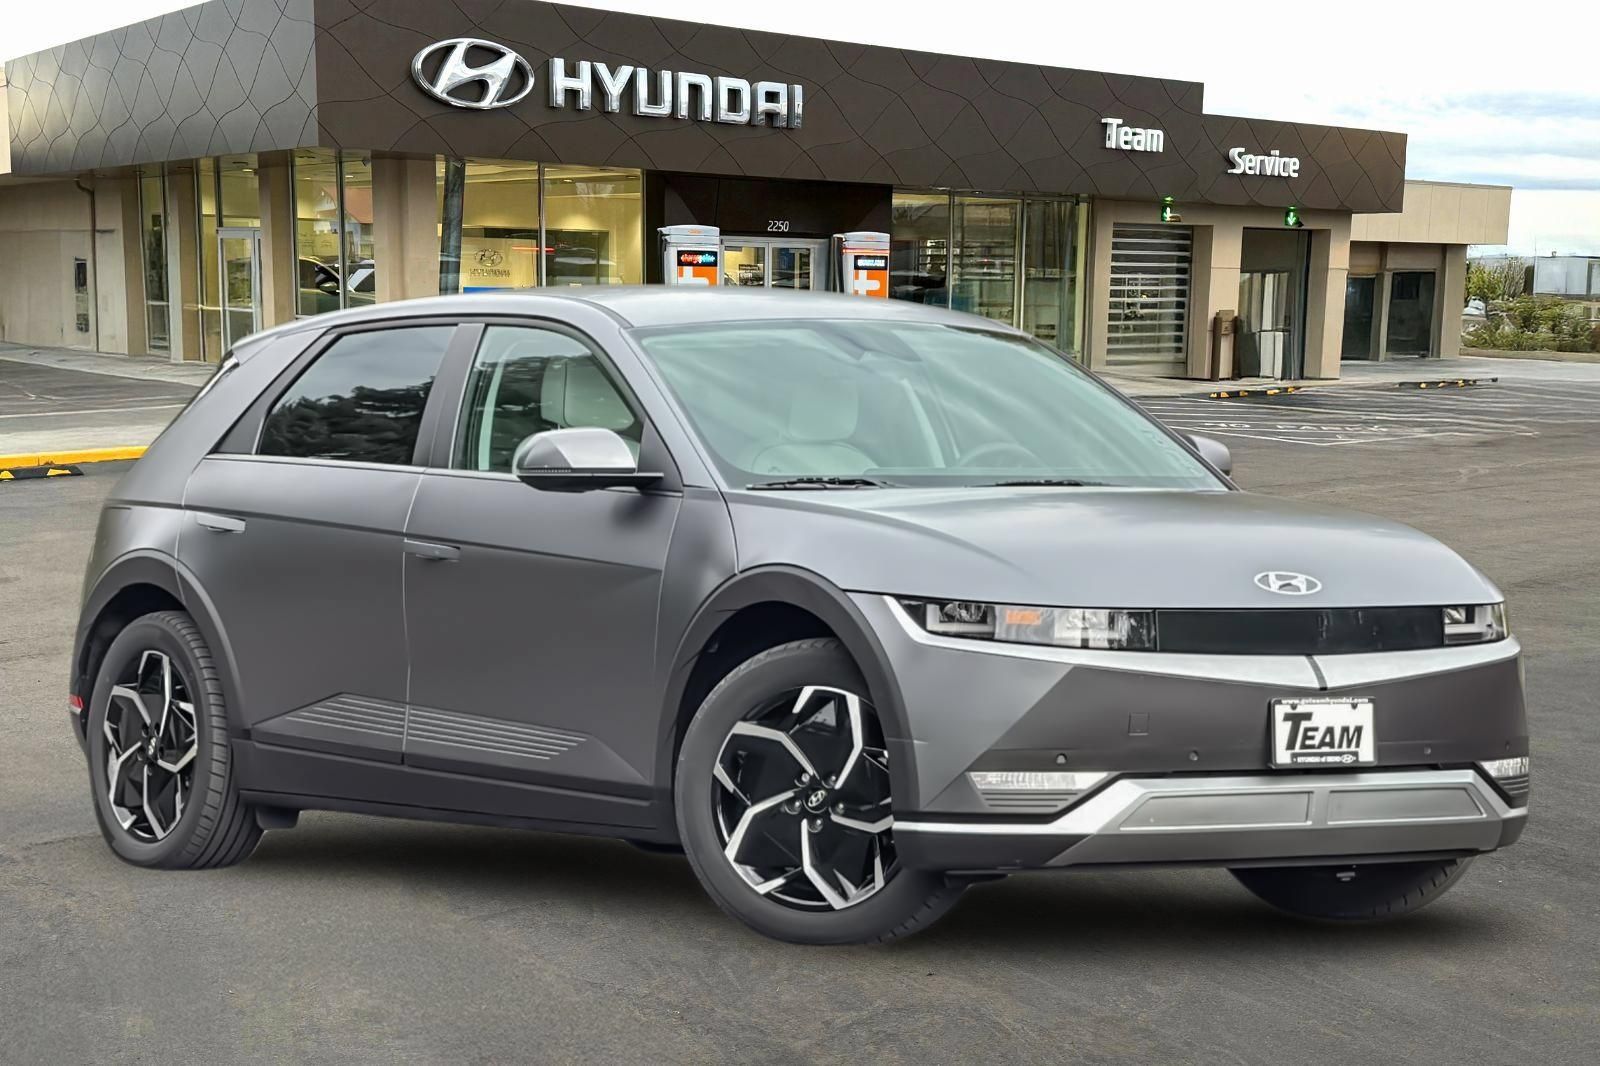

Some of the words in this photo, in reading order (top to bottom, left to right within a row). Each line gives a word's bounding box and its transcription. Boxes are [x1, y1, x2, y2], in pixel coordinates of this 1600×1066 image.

[549, 57, 803, 129] HYUNDAI
[1101, 117, 1164, 153] Team
[1227, 147, 1300, 178] Service
[767, 220, 790, 232] 2250
[1282, 711, 1364, 751] TEAM
